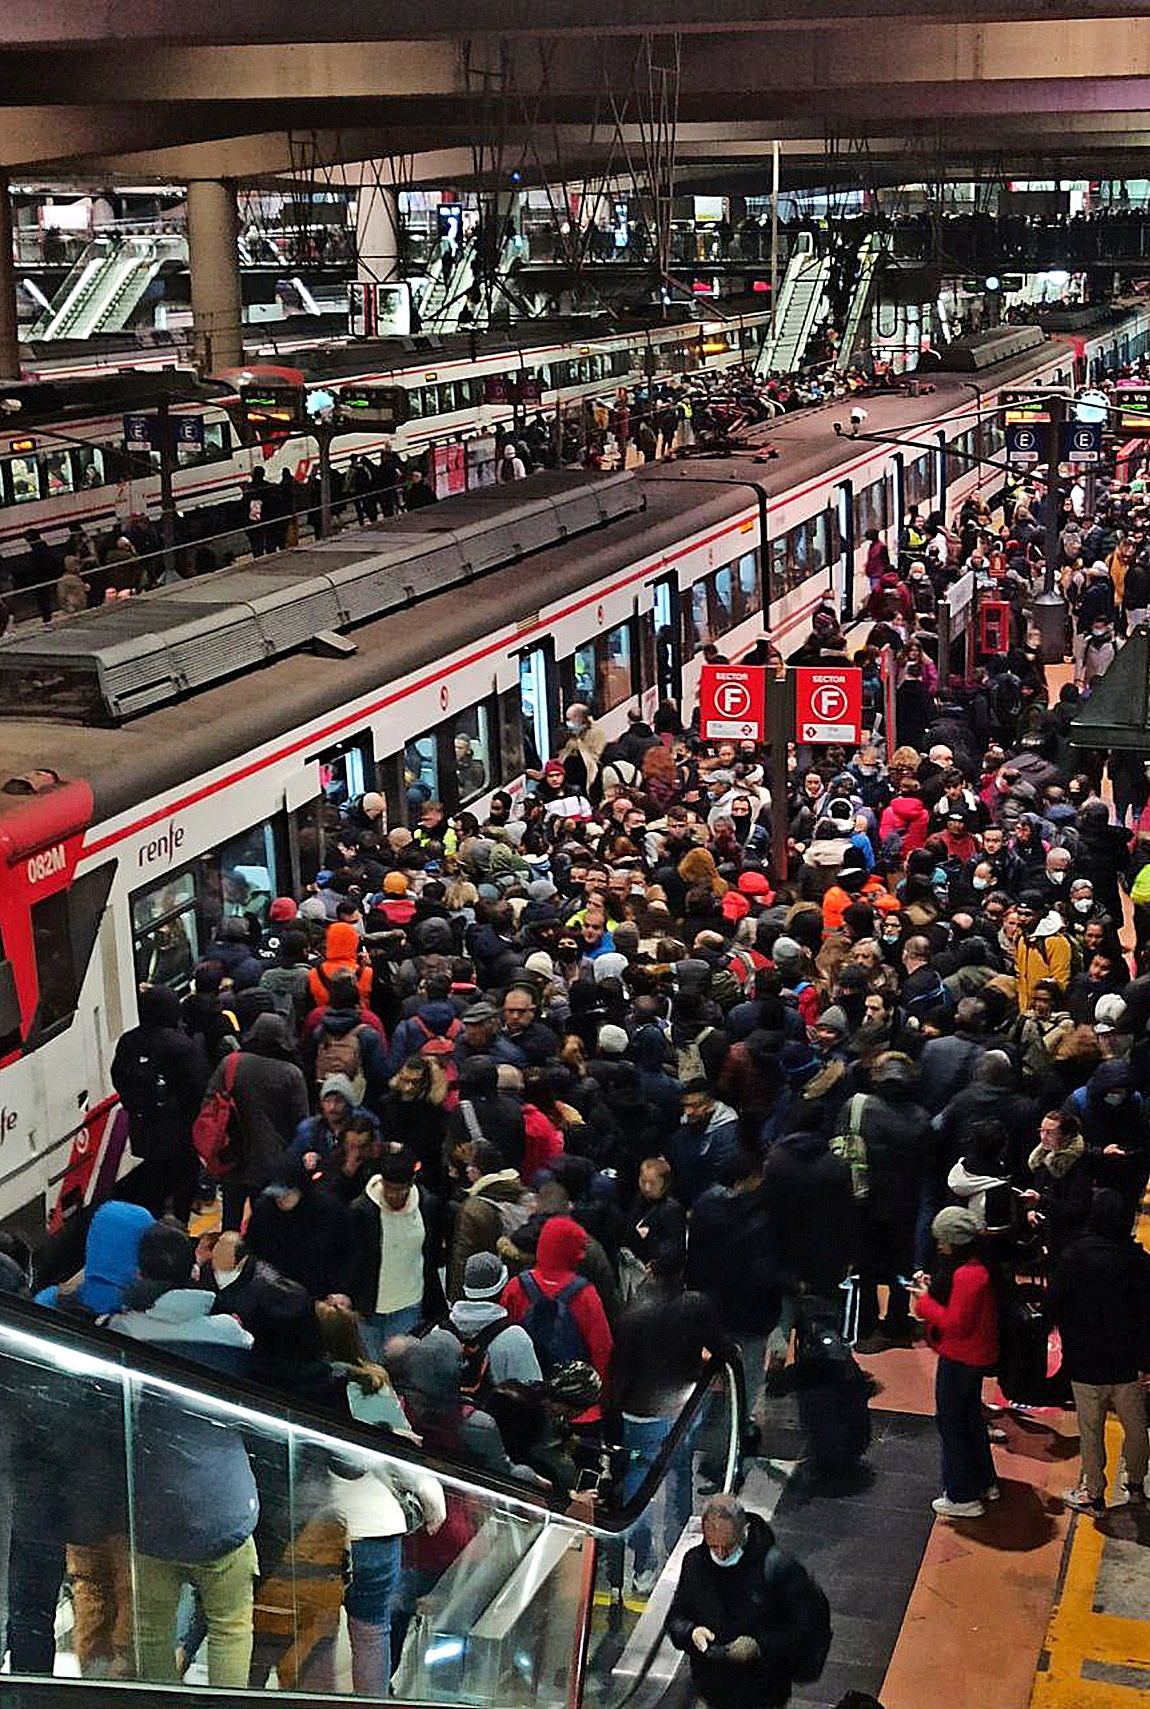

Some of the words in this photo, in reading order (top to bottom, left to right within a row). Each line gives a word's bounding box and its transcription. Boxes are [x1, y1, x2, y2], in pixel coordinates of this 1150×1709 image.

[1019, 433, 1029, 447] E
[1079, 433, 1089, 447] E
[715, 672, 748, 680] SECTOR
[811, 675, 846, 683] SECTOR
[724, 688, 743, 712] F
[821, 691, 840, 715] F
[138, 819, 185, 867] renfe
[27, 844, 67, 884] 082M
